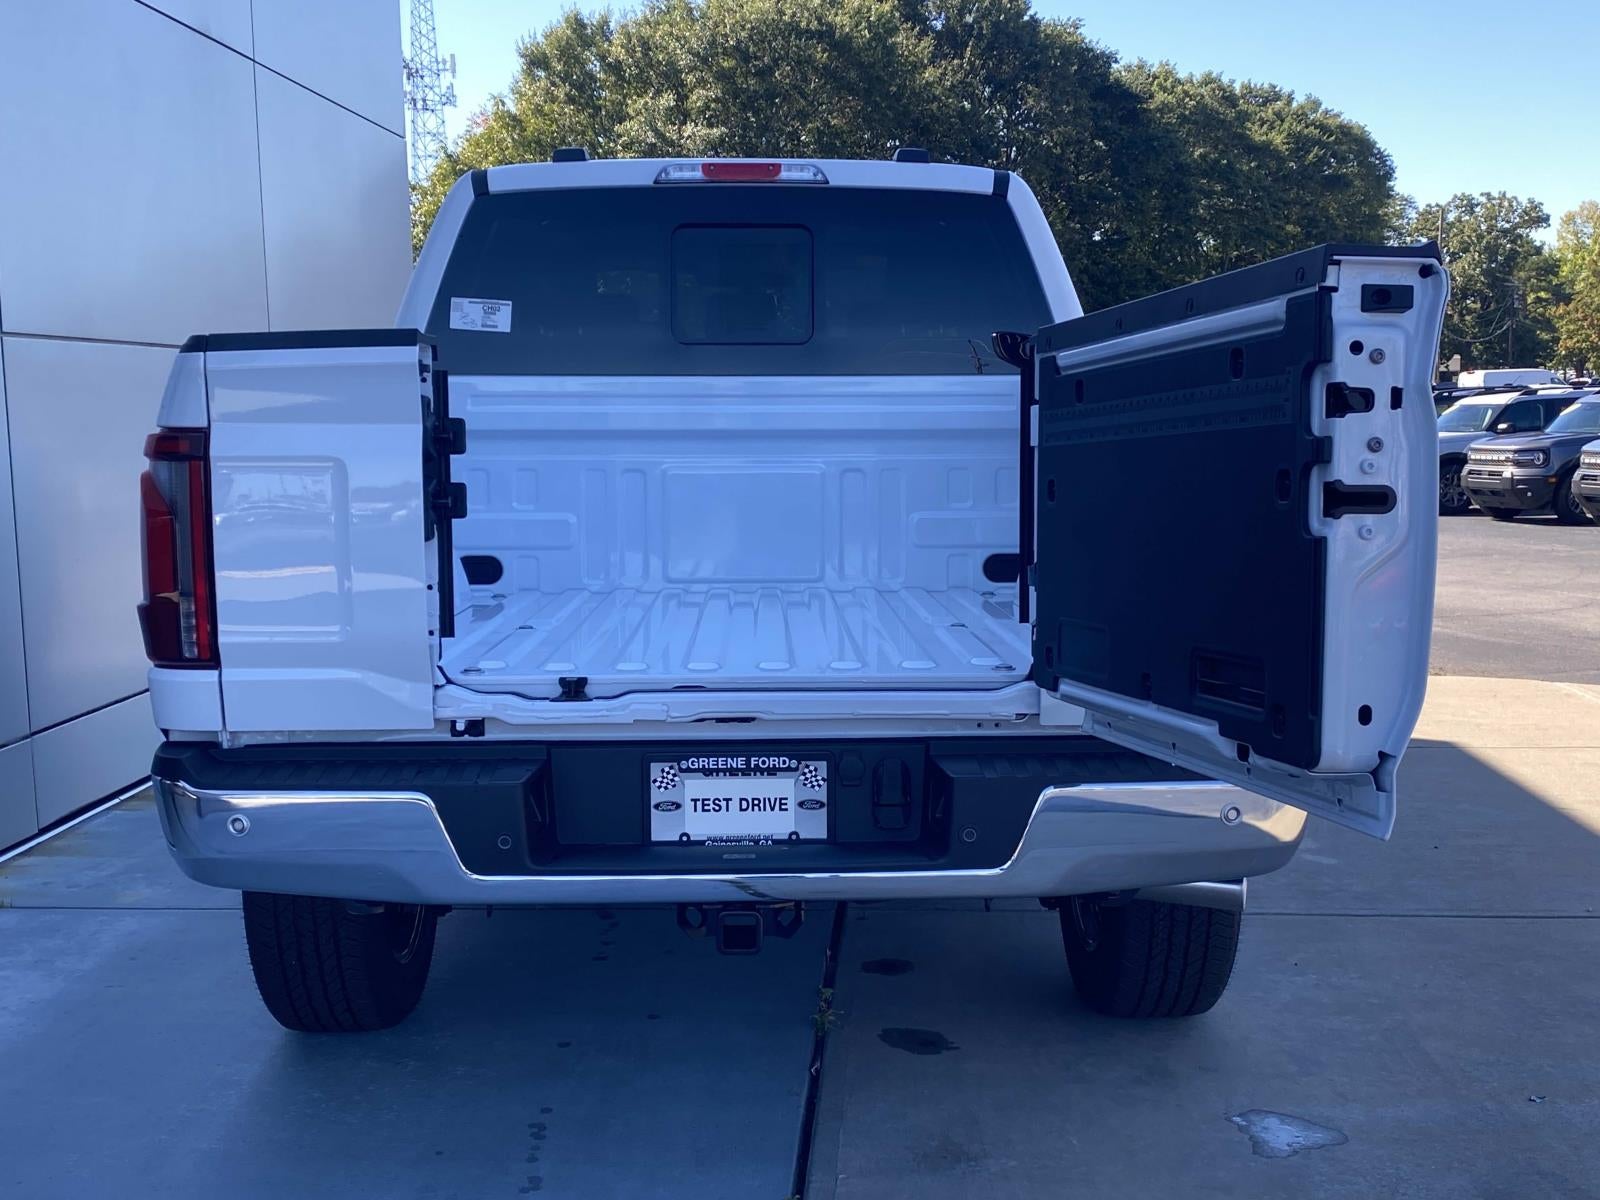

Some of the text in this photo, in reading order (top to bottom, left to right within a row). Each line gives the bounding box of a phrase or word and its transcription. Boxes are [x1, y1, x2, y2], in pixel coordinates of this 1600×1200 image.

[688, 757, 790, 769] GREENE FORD
[690, 797, 789, 813] TEST DRIVE
